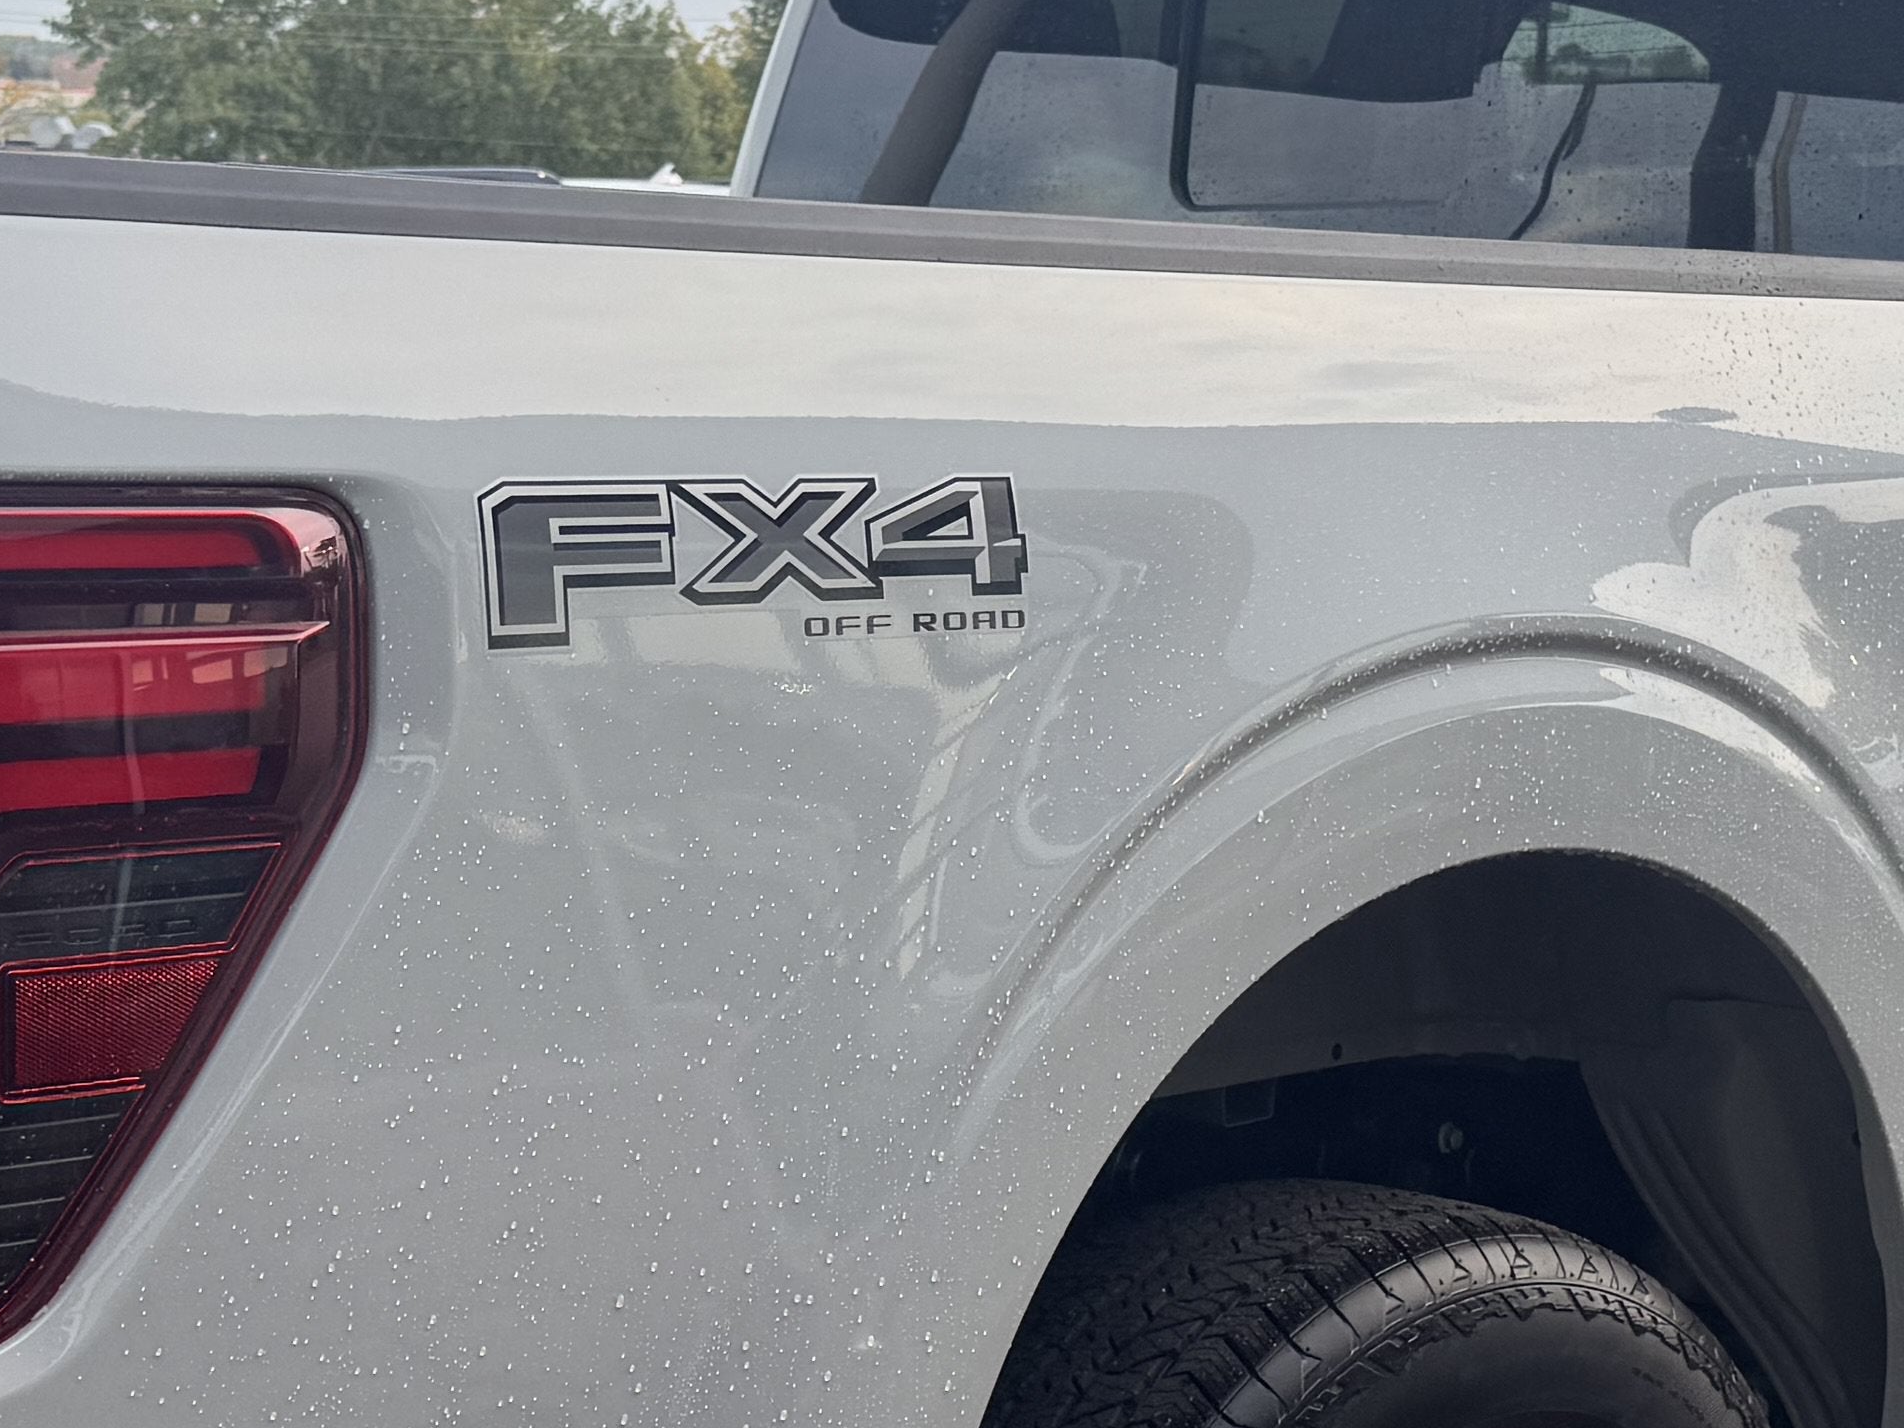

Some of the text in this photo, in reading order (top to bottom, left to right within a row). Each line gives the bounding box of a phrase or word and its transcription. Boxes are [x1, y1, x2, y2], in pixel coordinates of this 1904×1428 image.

[476, 475, 1028, 651] FX4
[803, 608, 1027, 638] OFF ROAD
